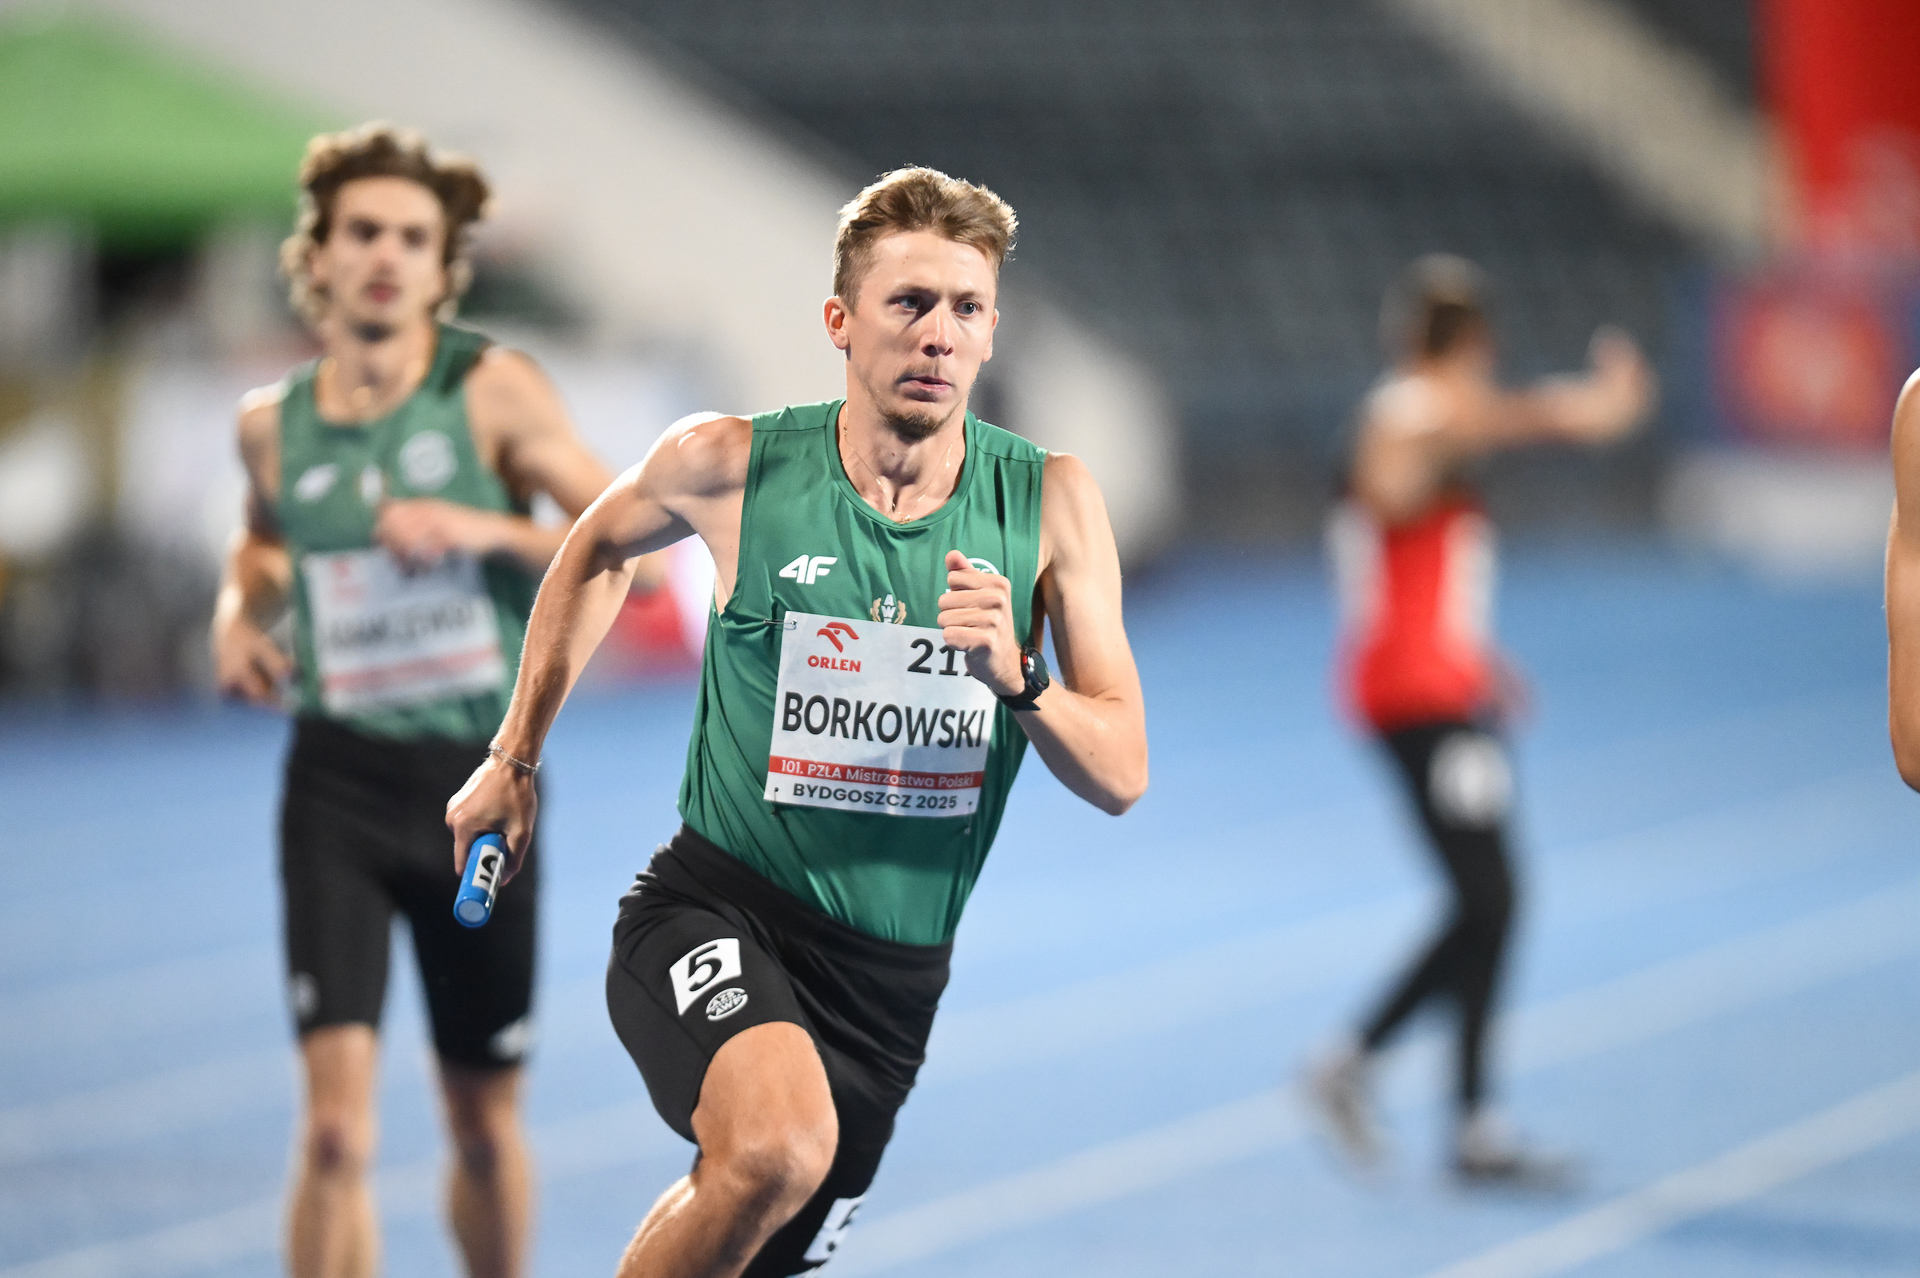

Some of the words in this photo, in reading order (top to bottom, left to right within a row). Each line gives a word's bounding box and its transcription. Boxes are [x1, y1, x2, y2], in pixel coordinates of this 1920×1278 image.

[779, 554, 838, 585] 4F
[807, 655, 862, 673] ORLEN
[907, 638, 971, 677] 21
[782, 691, 986, 749] BORKOWSKI
[781, 758, 803, 775] 101.
[807, 763, 842, 779] PZLA
[846, 768, 934, 788] Mistrzostwa
[938, 773, 975, 788] Polski
[793, 782, 912, 809] BYDGOSZCZ
[916, 795, 958, 809] 2025
[687, 944, 723, 992] 5
